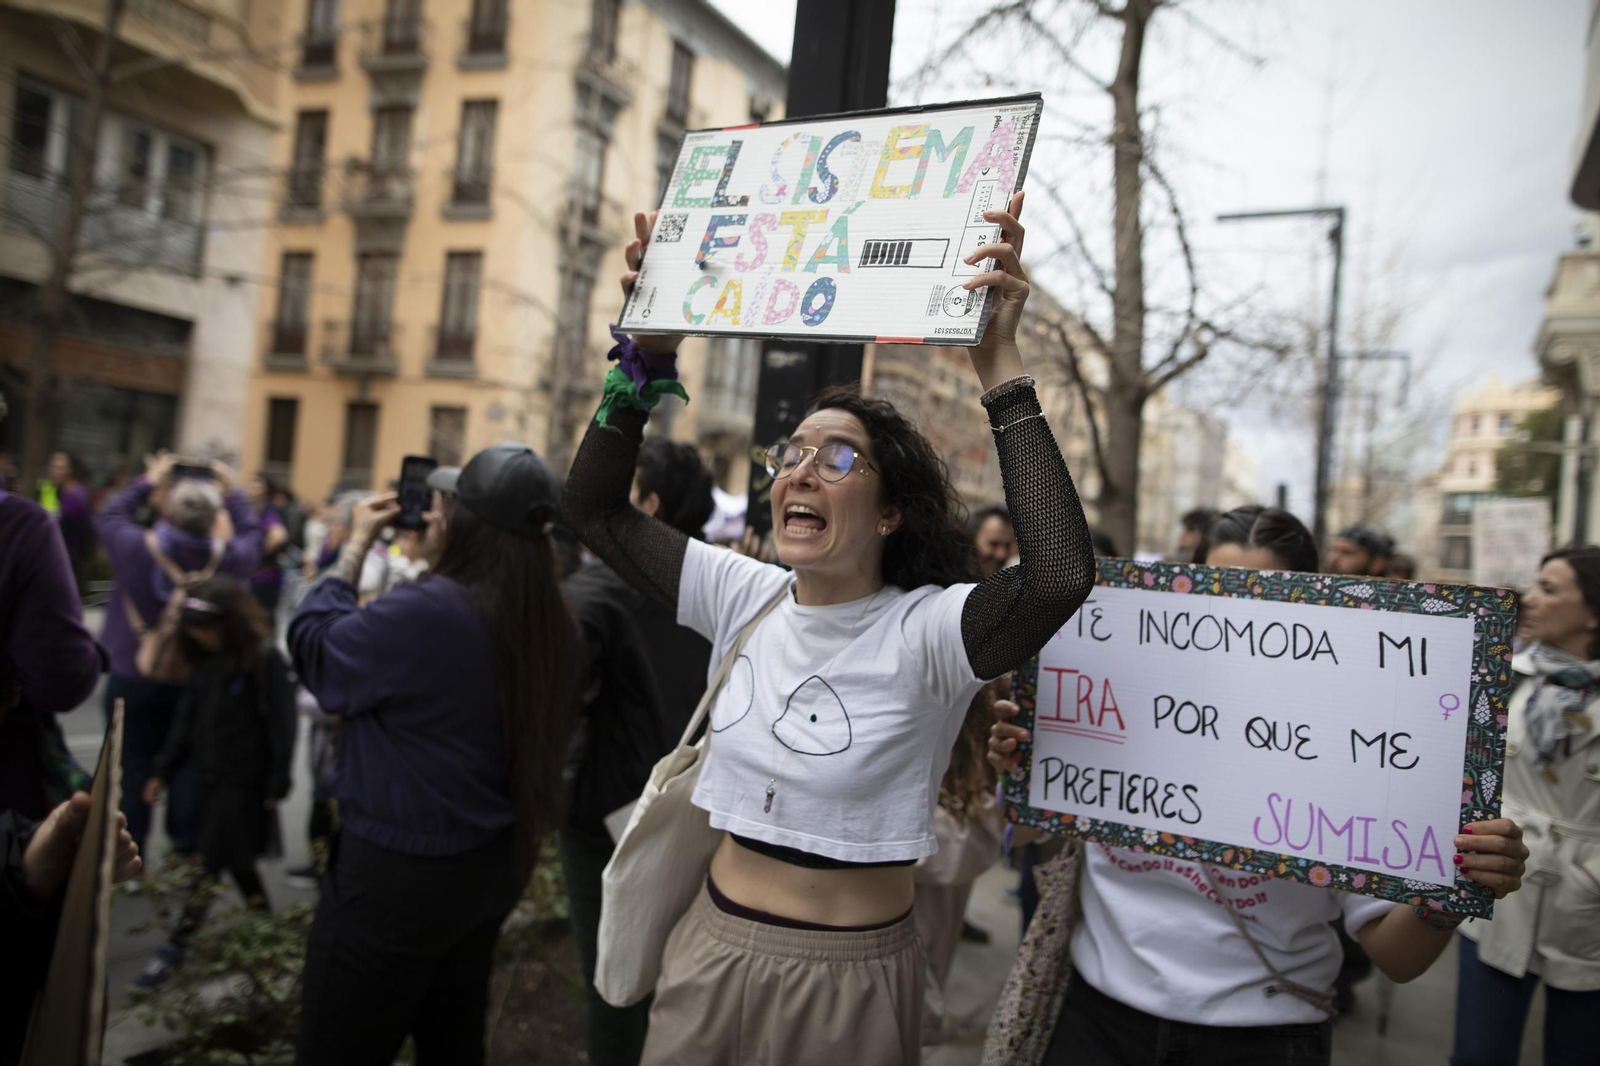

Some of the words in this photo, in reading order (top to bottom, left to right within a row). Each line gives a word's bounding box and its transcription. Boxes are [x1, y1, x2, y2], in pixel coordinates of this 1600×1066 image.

[672, 140, 750, 208] EL
[758, 120, 1015, 205] SISTEMA
[1078, 600, 1112, 641] TE
[1139, 608, 1338, 665] INCOMODA
[1378, 631, 1428, 677] MI
[1038, 666, 1126, 730] IRA
[1154, 694, 1220, 740] POR
[1245, 716, 1318, 760] QUE
[1351, 728, 1420, 770] ME
[1039, 756, 1202, 825] PREFIERES
[1253, 792, 1446, 877] SUMISA
